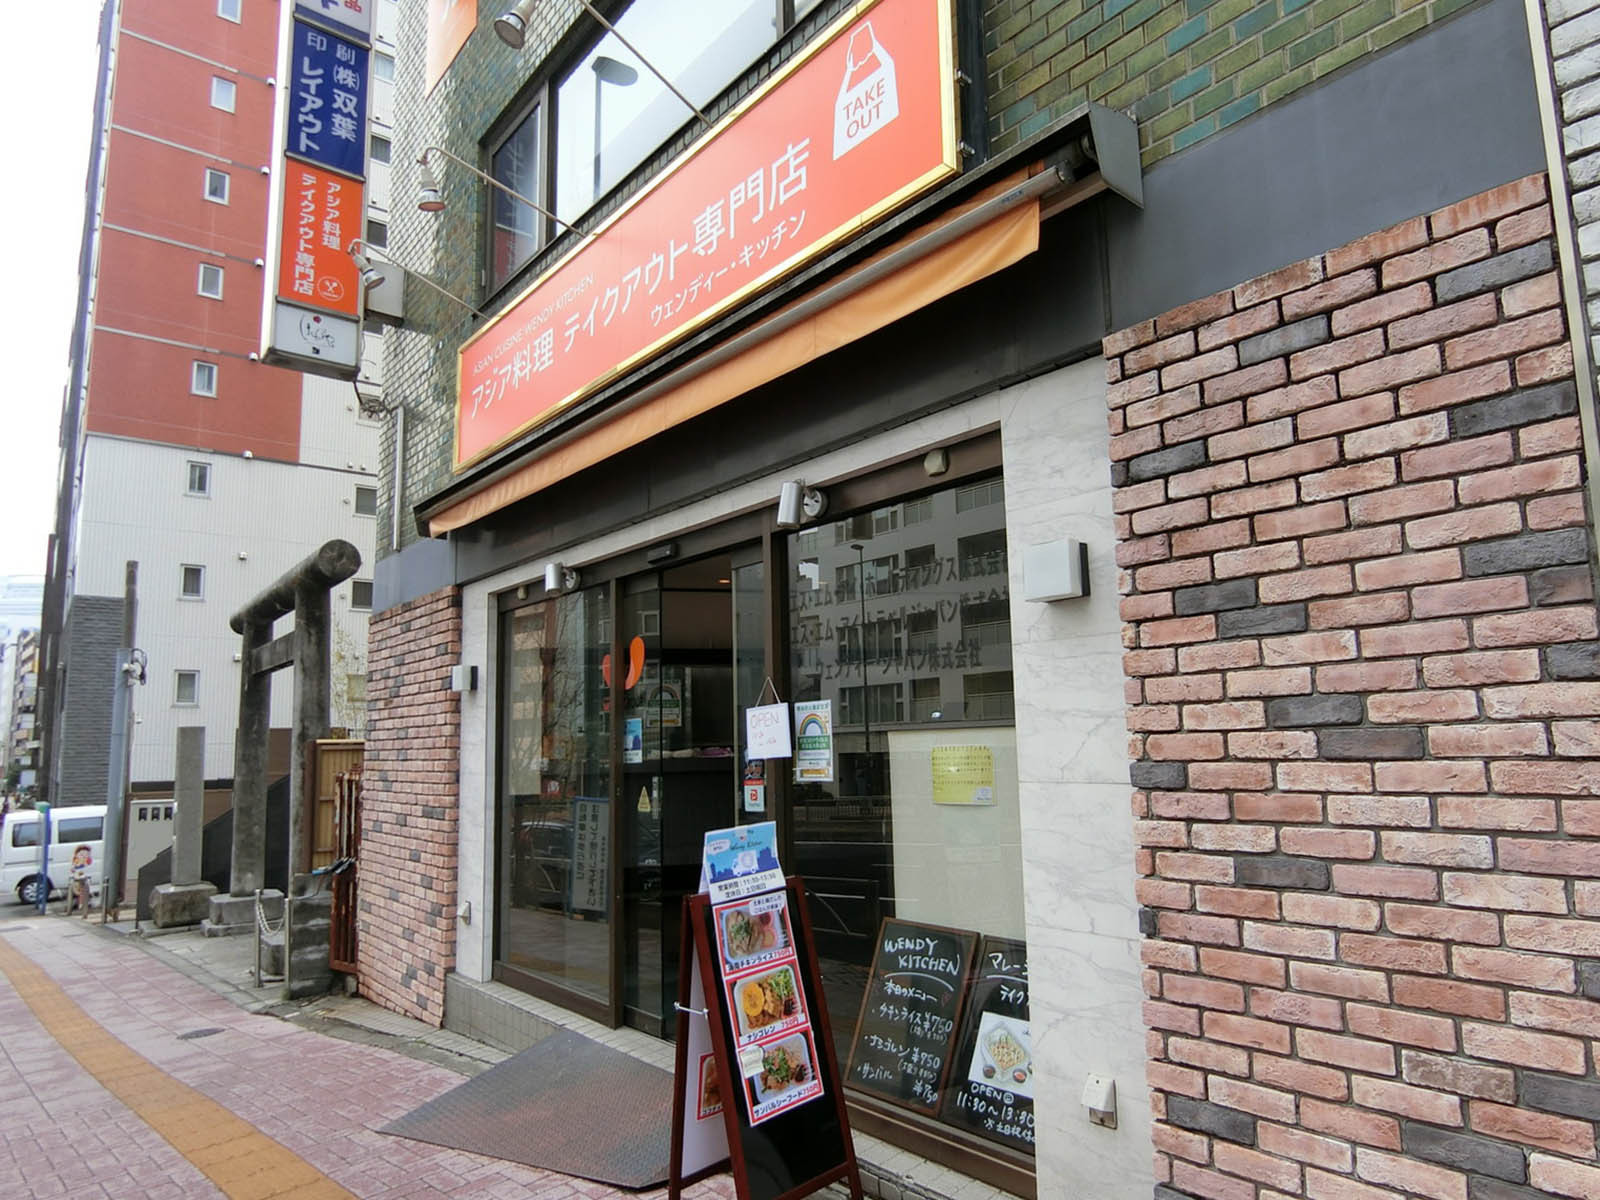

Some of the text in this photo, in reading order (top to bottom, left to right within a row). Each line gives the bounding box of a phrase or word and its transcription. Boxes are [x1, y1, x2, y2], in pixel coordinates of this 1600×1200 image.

[299, 57, 324, 152] レイアウト
[843, 78, 886, 122] TAKE
[846, 102, 882, 139] OUT
[294, 174, 317, 296] テイクアウト専門店
[322, 181, 341, 251] アジア料理
[472, 137, 811, 419] アジア料理 テイクアウト専門店
[884, 937, 938, 955] WENDY
[898, 954, 960, 976] KITCHEN
[884, 979, 938, 1002] 本日のメニュー
[971, 1083, 1002, 1100] OPEN
